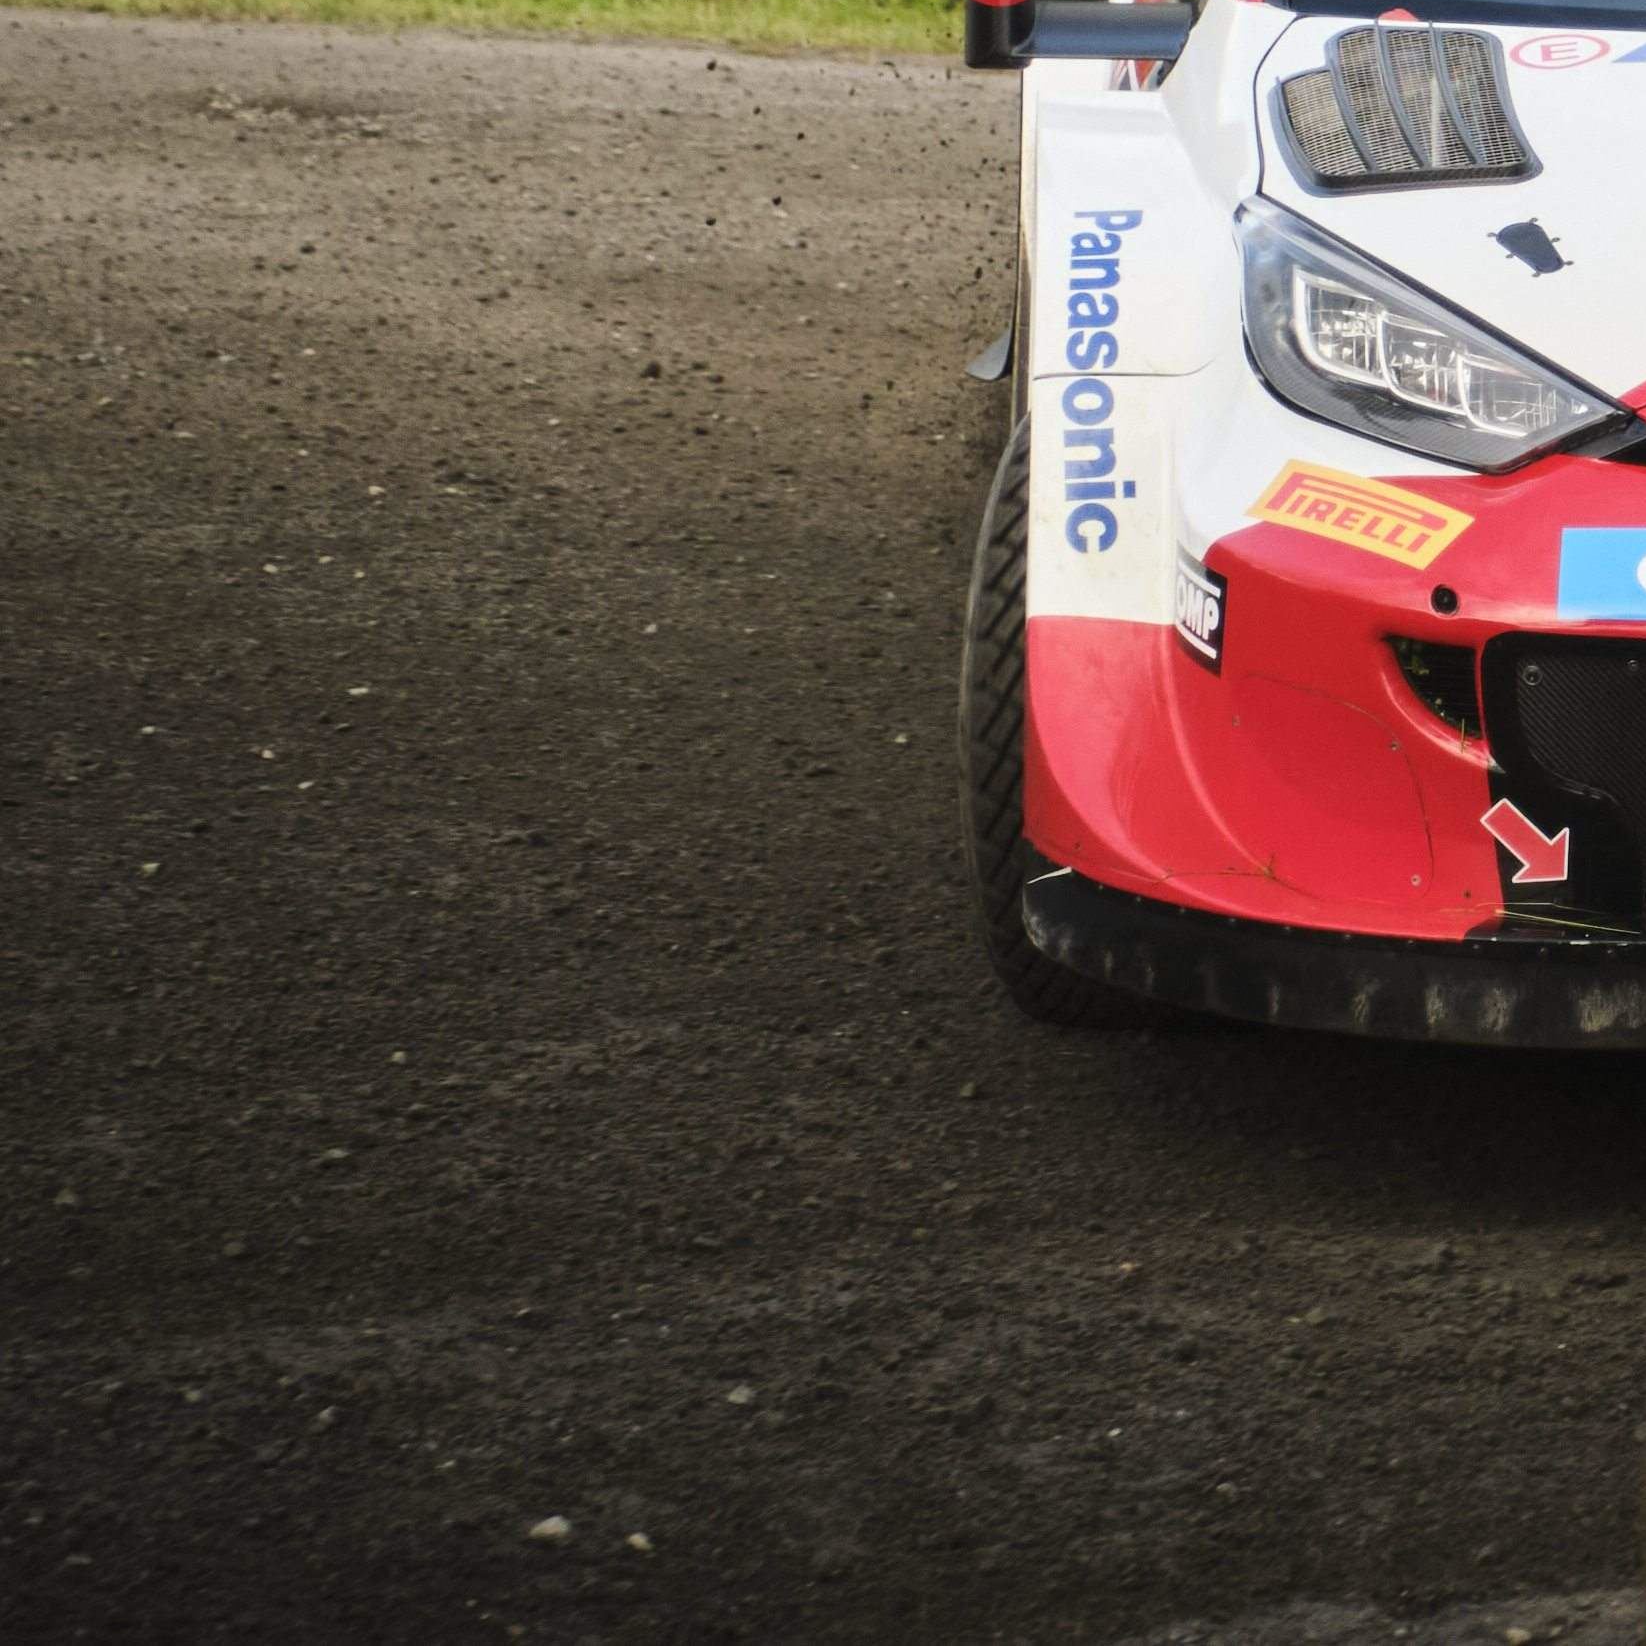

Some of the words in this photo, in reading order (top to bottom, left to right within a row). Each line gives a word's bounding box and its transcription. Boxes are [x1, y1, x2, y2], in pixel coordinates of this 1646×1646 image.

[1063, 209, 1144, 554] Panasonic
[1269, 471, 1447, 555] PIRELLI
[1176, 575, 1220, 641] OMP
